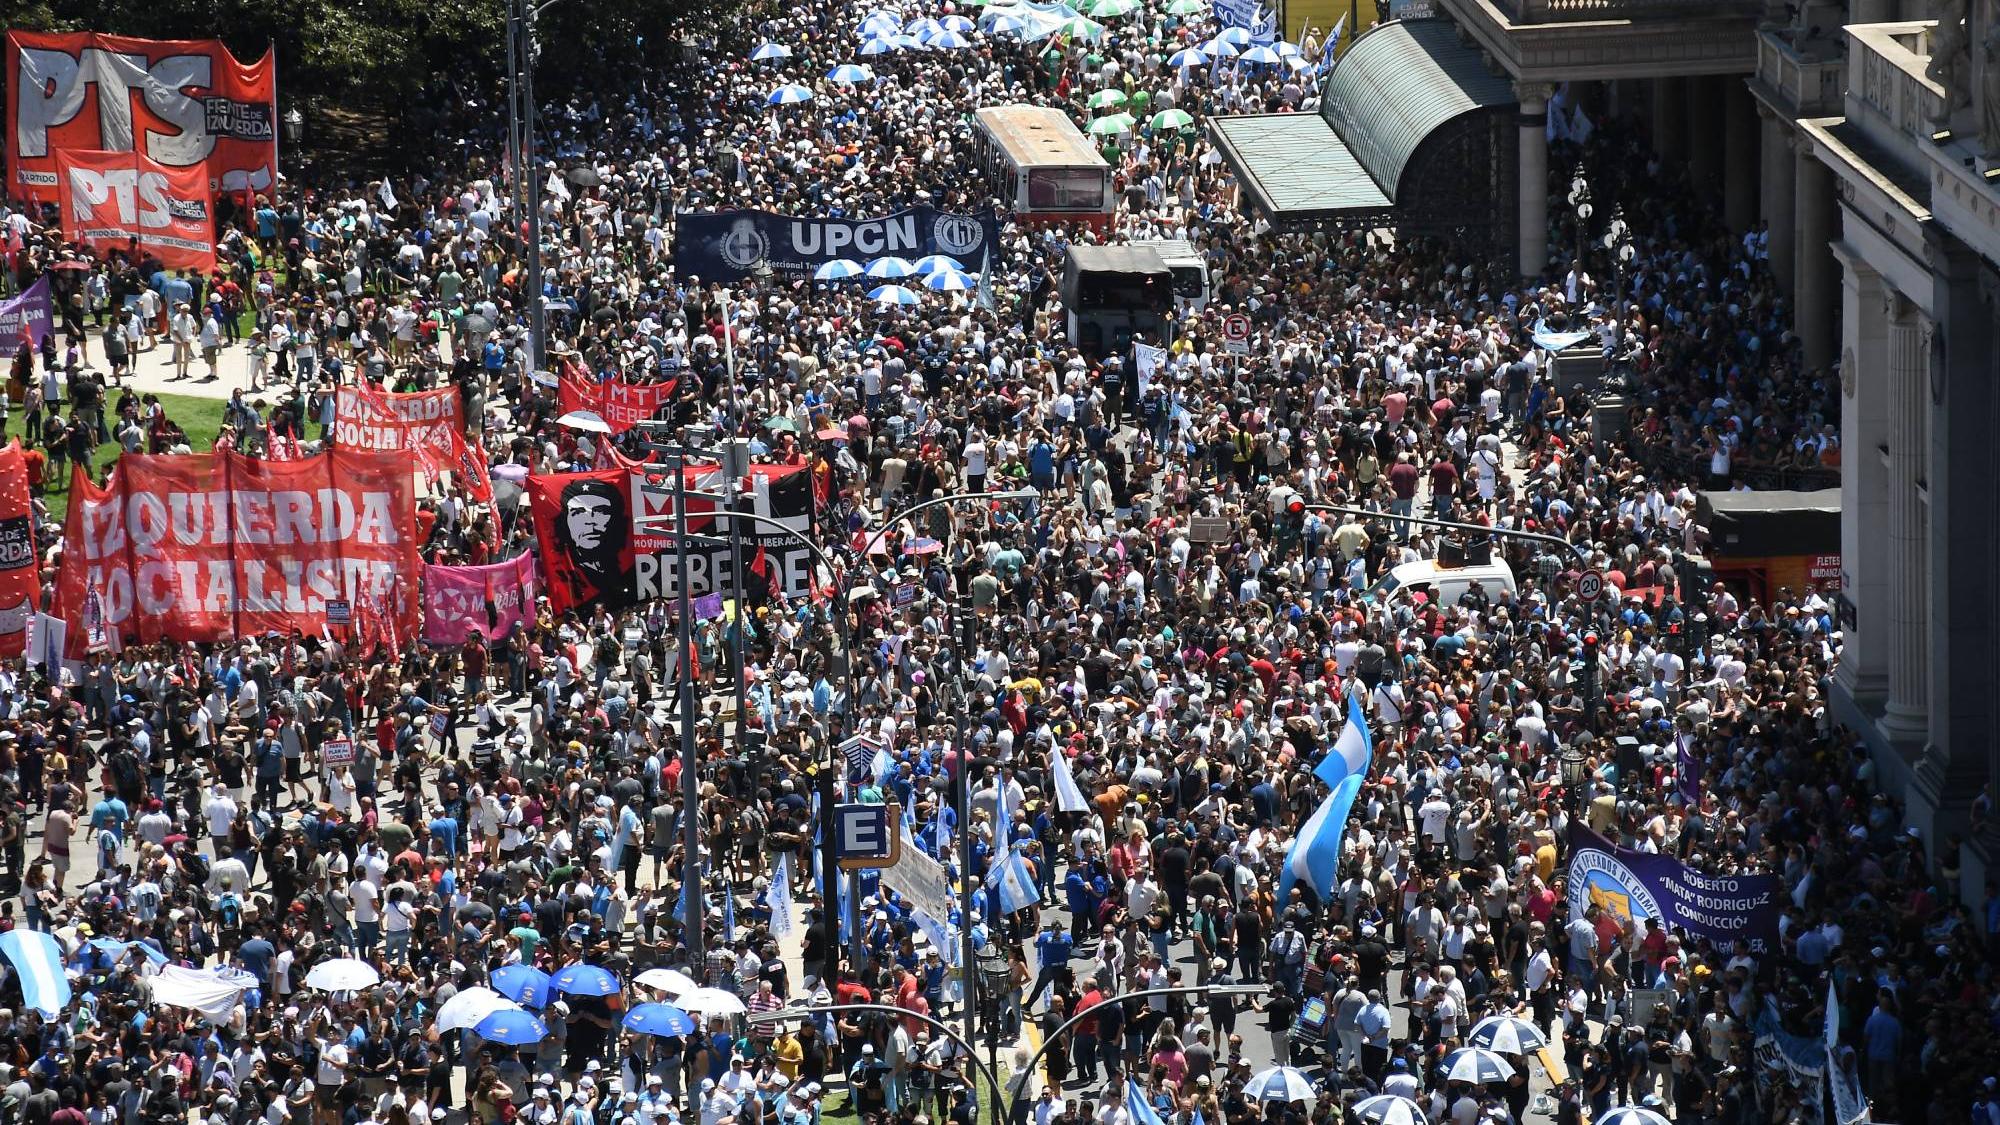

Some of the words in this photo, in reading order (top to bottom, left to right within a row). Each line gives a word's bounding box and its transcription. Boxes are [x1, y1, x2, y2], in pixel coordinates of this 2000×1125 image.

[18, 47, 213, 166] PTS
[250, 111, 263, 120] DE
[19, 172, 56, 184] ARTIDO
[69, 166, 172, 229] PTS
[790, 215, 918, 256] UPCN
[611, 384, 670, 405] MTL
[81, 487, 398, 560] IZQUIERDA
[633, 538, 692, 550] MOVIMIENO
[757, 534, 810, 549] LIBERACN
[1817, 557, 1841, 567] FLETES
[635, 548, 810, 600] REBEDE
[1583, 579, 1598, 593] 20
[843, 811, 878, 851] E
[1683, 870, 1739, 893] ROBERTO
